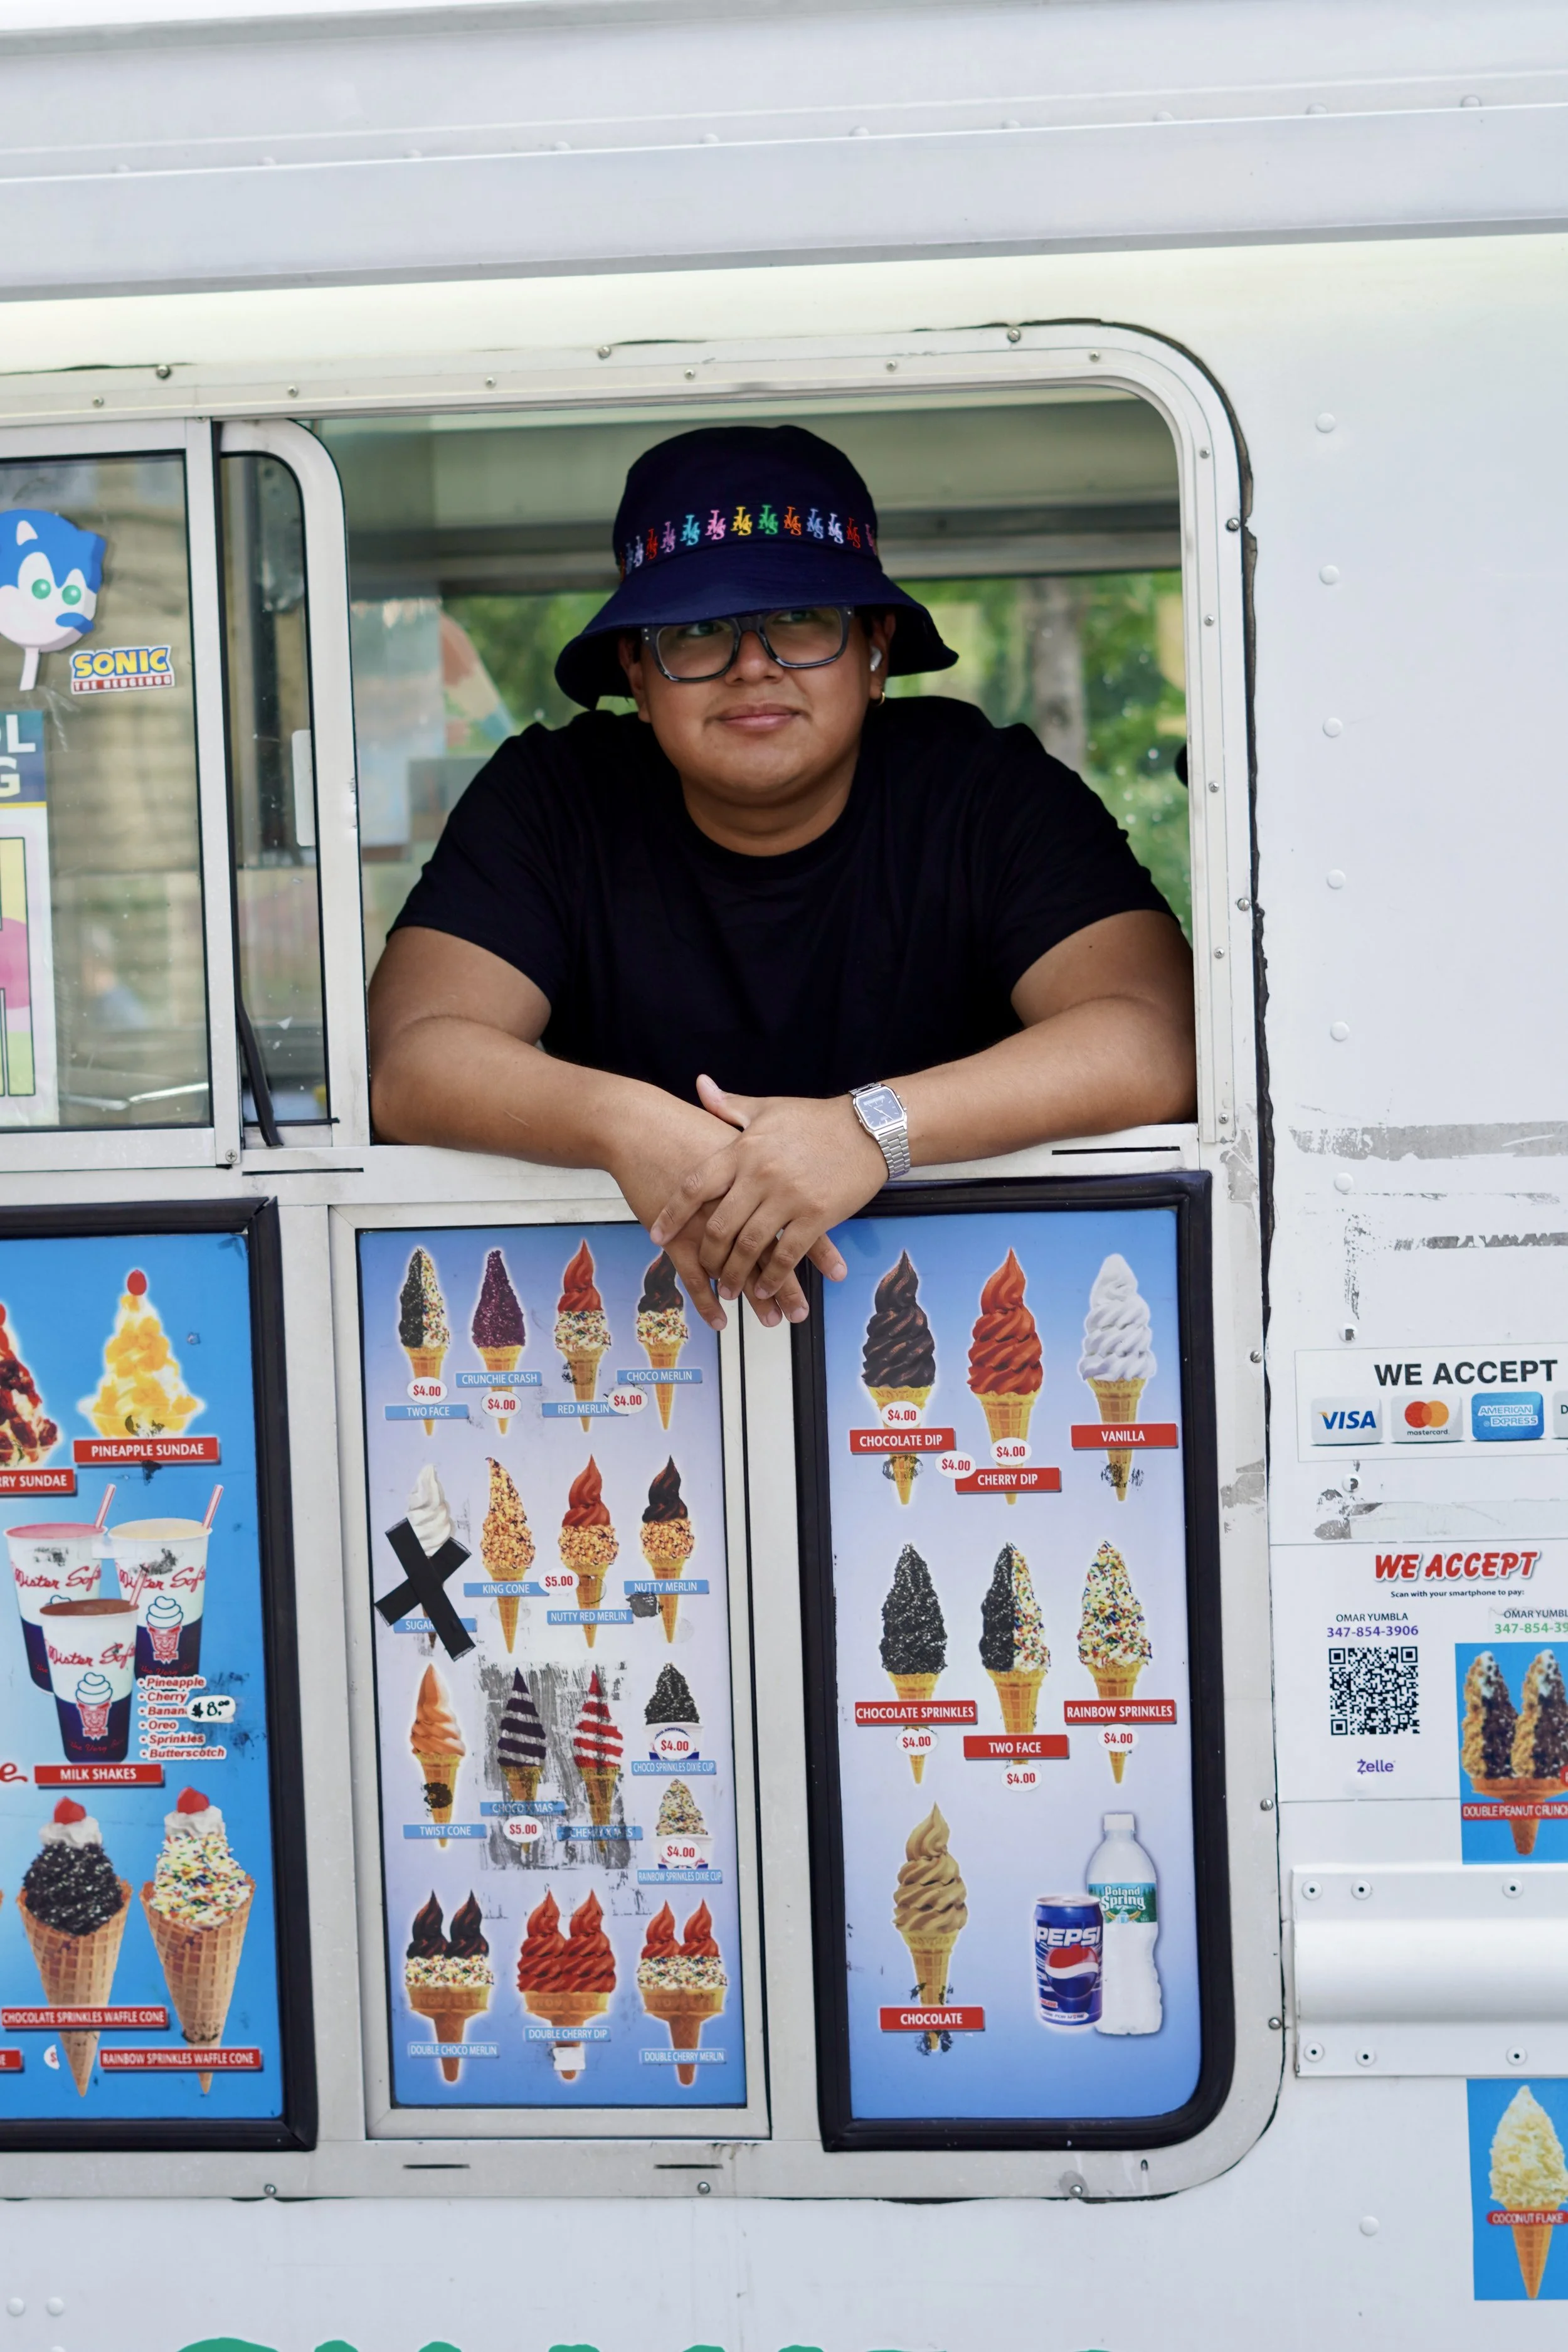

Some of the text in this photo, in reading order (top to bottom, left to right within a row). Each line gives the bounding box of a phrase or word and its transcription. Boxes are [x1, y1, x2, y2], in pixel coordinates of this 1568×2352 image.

[73, 648, 169, 678] SONIC
[75, 675, 171, 691] THE HEDGEHOG
[0, 714, 36, 753] L
[627, 1370, 692, 1381] CHOCO MERLIN
[1374, 1360, 1557, 1386] WE ACCEPT
[462, 1374, 538, 1384] CRUNCHIE CRASH
[413, 1384, 441, 1397] $4.00
[488, 1398, 516, 1411] $4.00
[613, 1394, 642, 1407] $4.00
[406, 1406, 450, 1417] TWO FACE
[558, 1404, 610, 1414] RED MERLIN
[1479, 1406, 1532, 1415] AMERICAN
[887, 1409, 916, 1421] $4.00
[1318, 1411, 1376, 1429] VISA
[1492, 1416, 1537, 1426] EXPRESS
[859, 1434, 943, 1447] CHOCOLATE DIP
[1101, 1431, 1145, 1442] VANILLA
[91, 1443, 204, 1458] PINEAPPLE SUNDAE
[997, 1446, 1025, 1458] $4.00
[941, 1458, 971, 1471] $4.00
[19, 1475, 67, 1488] SUNDAE
[977, 1474, 1038, 1486] CHERRY DIP
[1375, 1551, 1537, 1579] WE ACCEPT
[115, 1562, 164, 1591] Miter
[545, 1576, 573, 1587] $5.00
[482, 1584, 530, 1594] KING CONE
[634, 1582, 697, 1592] NUTTY MERLIN
[1449, 1589, 1496, 1598] smartphone
[551, 1611, 627, 1621] NUTTY RED MERLIN
[1336, 1613, 1408, 1622] OMAR YUMBLA
[1504, 1610, 1534, 1619] OMAR
[406, 1620, 434, 1630] SUGAR
[1327, 1625, 1419, 1638] 347-854-3906
[147, 1677, 204, 1688] Pineapple
[147, 1692, 188, 1702] Cherry
[856, 1707, 974, 1719] CHOCOLATE SPRINKLES
[1067, 1705, 1173, 1718] RAINBOW SPRINKLES
[149, 1720, 177, 1729] Oreo
[149, 1735, 204, 1745] Sprinkles
[903, 1735, 931, 1748] $4.00
[1104, 1732, 1133, 1744] $4.00
[661, 1739, 689, 1751] $4.00
[988, 1742, 1041, 1753] TWO FACE
[150, 1749, 225, 1758] Butterscotch
[633, 1762, 714, 1772] CHOCO SPRINKLES DIXIE CUP
[1357, 1759, 1394, 1774] Zelle
[60, 1767, 137, 1780] MILK SHAKES
[1007, 1772, 1035, 1785] $4.00
[492, 1803, 524, 1814] CHOCO
[534, 1803, 553, 1813] MAS
[1463, 1806, 1499, 1817] DOUBLE
[1499, 1806, 1534, 1816] PEANUT
[420, 1826, 472, 1836] TWIST CONE
[509, 1824, 537, 1835] $5.00
[614, 1828, 633, 1837] MS
[667, 1845, 695, 1857] $4.00
[638, 1872, 722, 1881] RAINBOW SPRINKLES DIXIE CUP
[1104, 1885, 1140, 1895] Poland
[1101, 1894, 1146, 1910] Spring
[1036, 1926, 1101, 1946] PEPSI
[3, 2011, 164, 2025] CHOCOLATE SPRINKLES WAFFLE CONE
[900, 2013, 963, 2025] CHOCOLATE
[529, 2029, 607, 2038] DOUBLE CHERRY DIP
[410, 2045, 497, 2055] DOUBLE CHOCO MERLIN
[102, 2052, 254, 2064] RAINBOW SPRINKLES WAFFLE CONE
[644, 2052, 724, 2061] DOUBLE CHERRY MERLIN
[1492, 2213, 1564, 2224] COCONUT FLAKE
